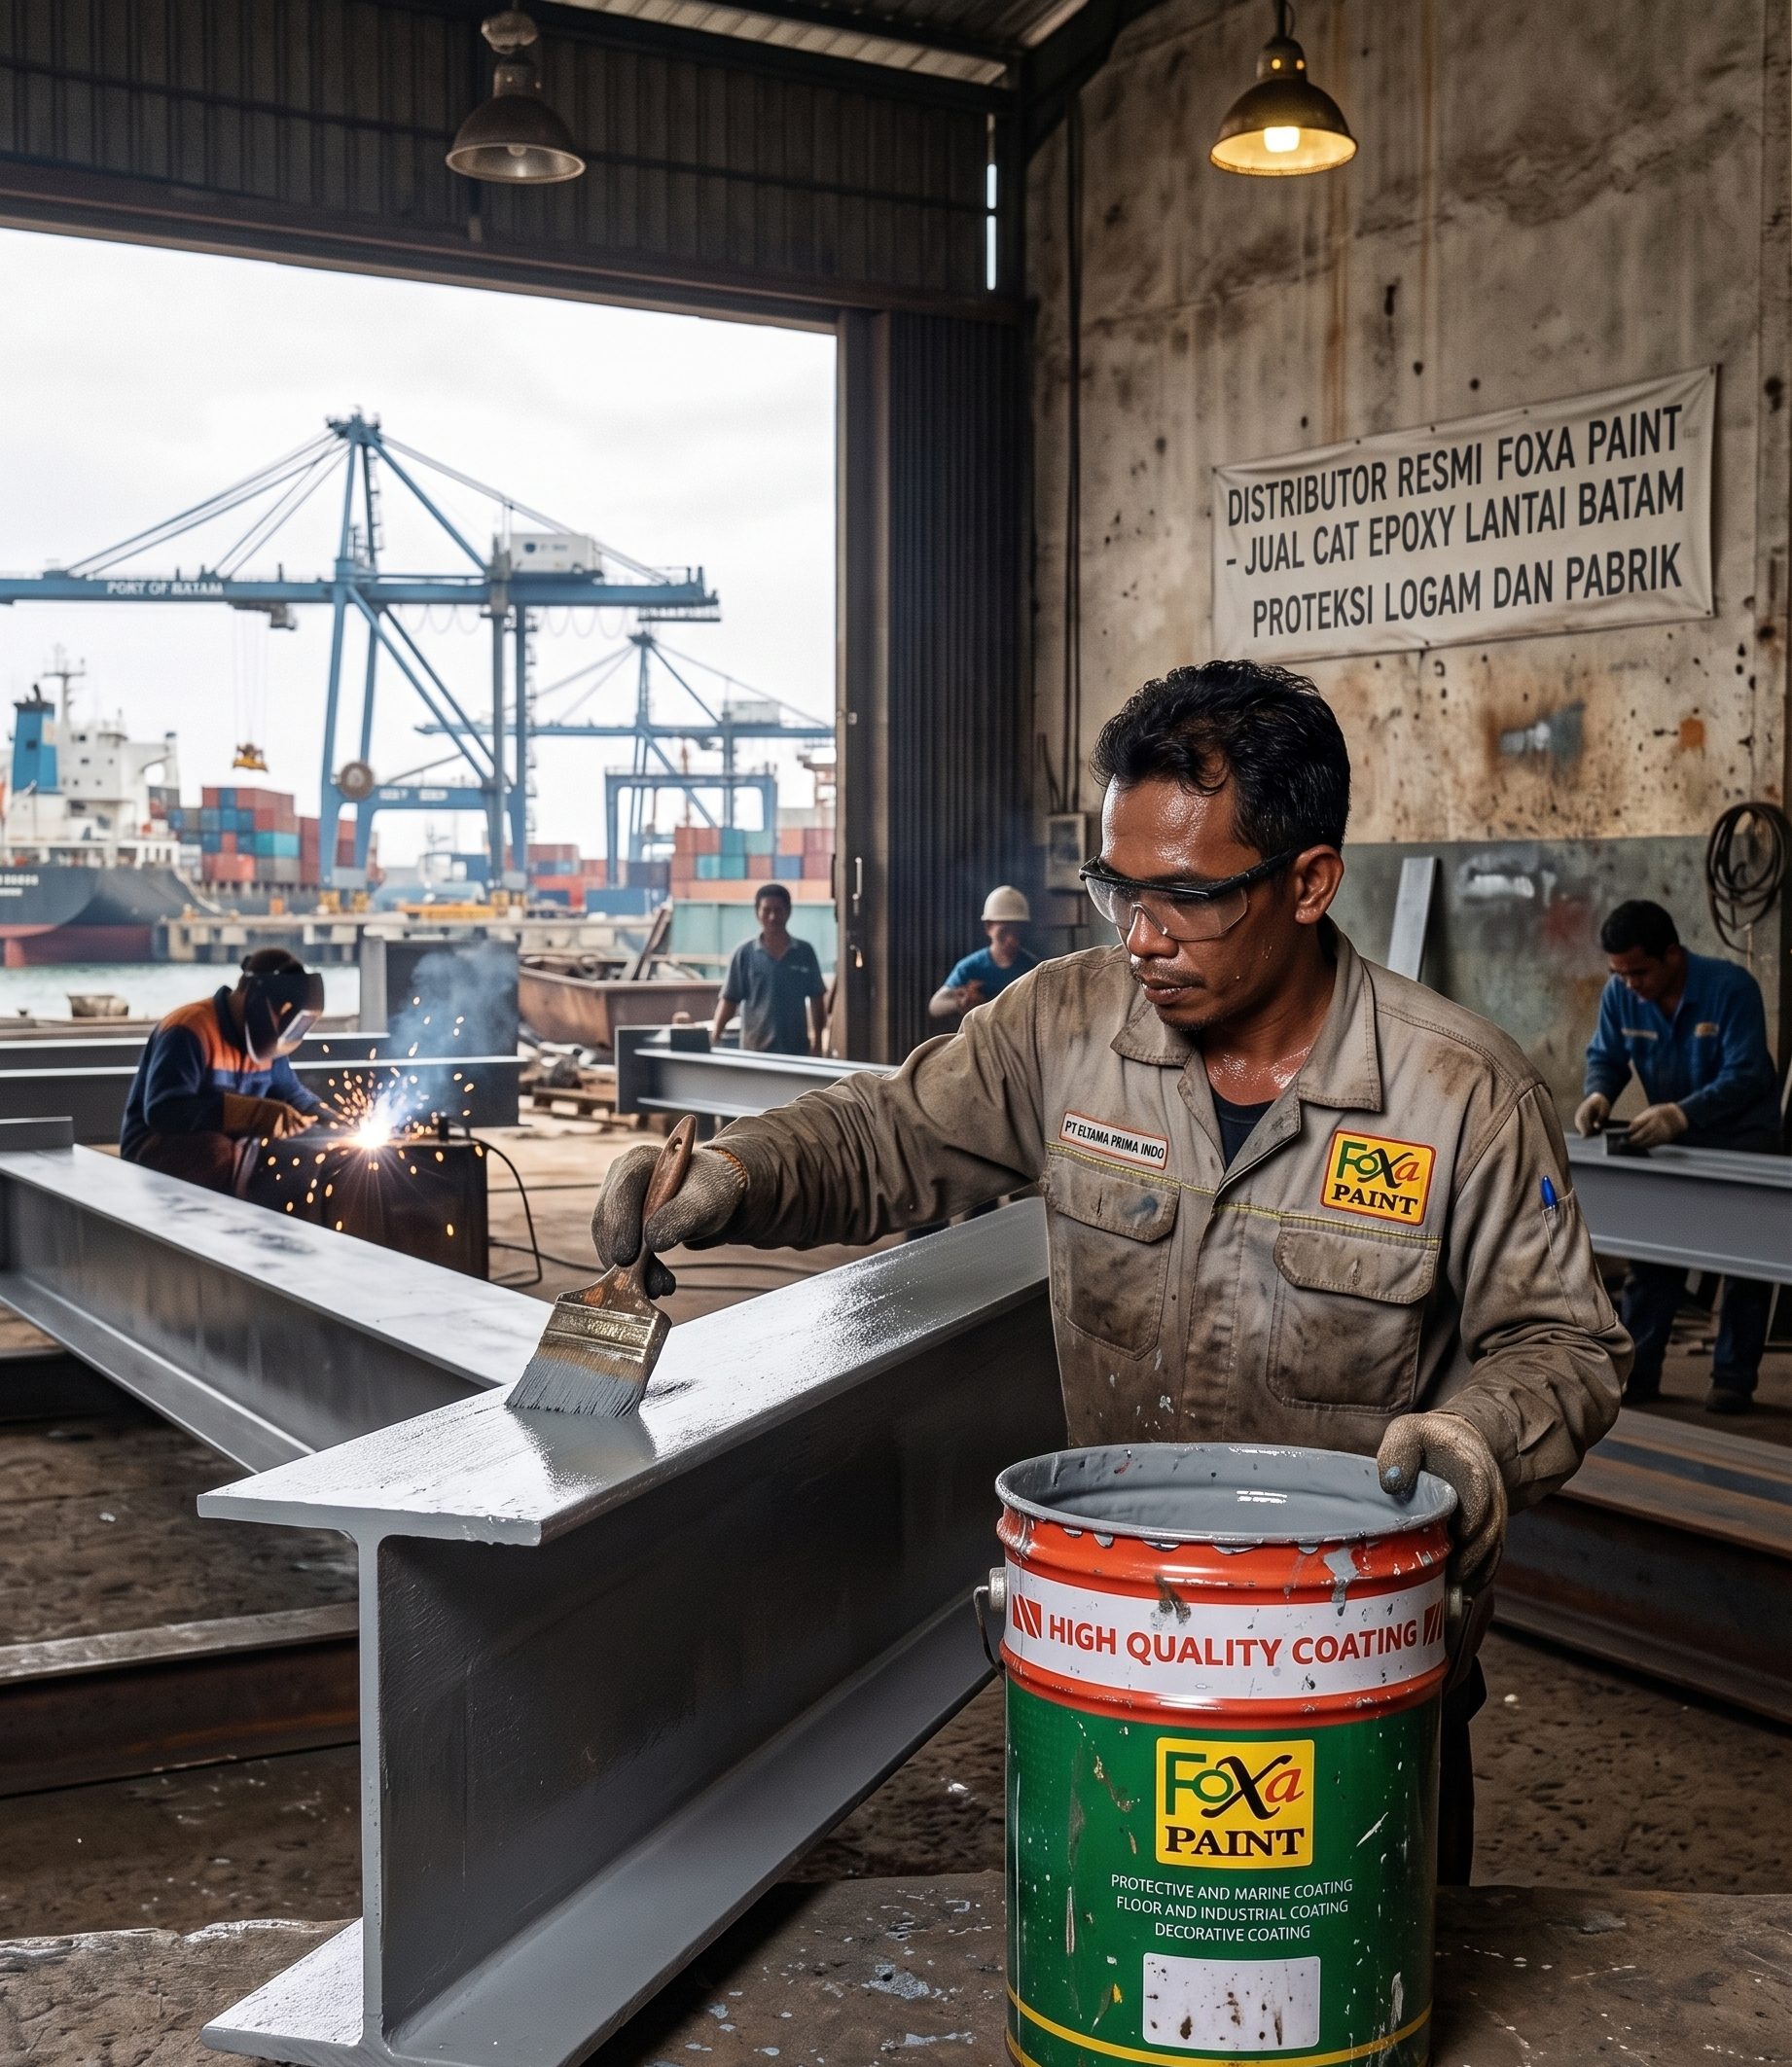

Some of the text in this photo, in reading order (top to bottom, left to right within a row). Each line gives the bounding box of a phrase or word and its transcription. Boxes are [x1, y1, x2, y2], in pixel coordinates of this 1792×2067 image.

[1228, 405, 1683, 526] DISTRIBUTOR RESMI FOXA PAINT
[1245, 530, 1305, 576] JUAL
[1313, 520, 1359, 566] CAT
[1369, 505, 1455, 556] EPOXY
[1466, 485, 1565, 544] LANTAI
[1579, 466, 1684, 526] BATAM
[148, 582, 167, 595] OF
[1253, 542, 1682, 637] PROTEKSI LOGAM DAN PABRIK
[1064, 1121, 1165, 1159] PT ELTAMA PRIMA INDO
[1331, 1183, 1418, 1215] PAINT
[1049, 1613, 1418, 1667] HIGH QUALITY COATING
[1165, 1825, 1305, 1857] PAINT
[1111, 1873, 1353, 1901] PROTECTIVE AND MARINE COATING
[1117, 1896, 1348, 1921] FLOOR AND INDUSTRIAL COATING
[1155, 1922, 1310, 1942] DECORATIVE COATING
